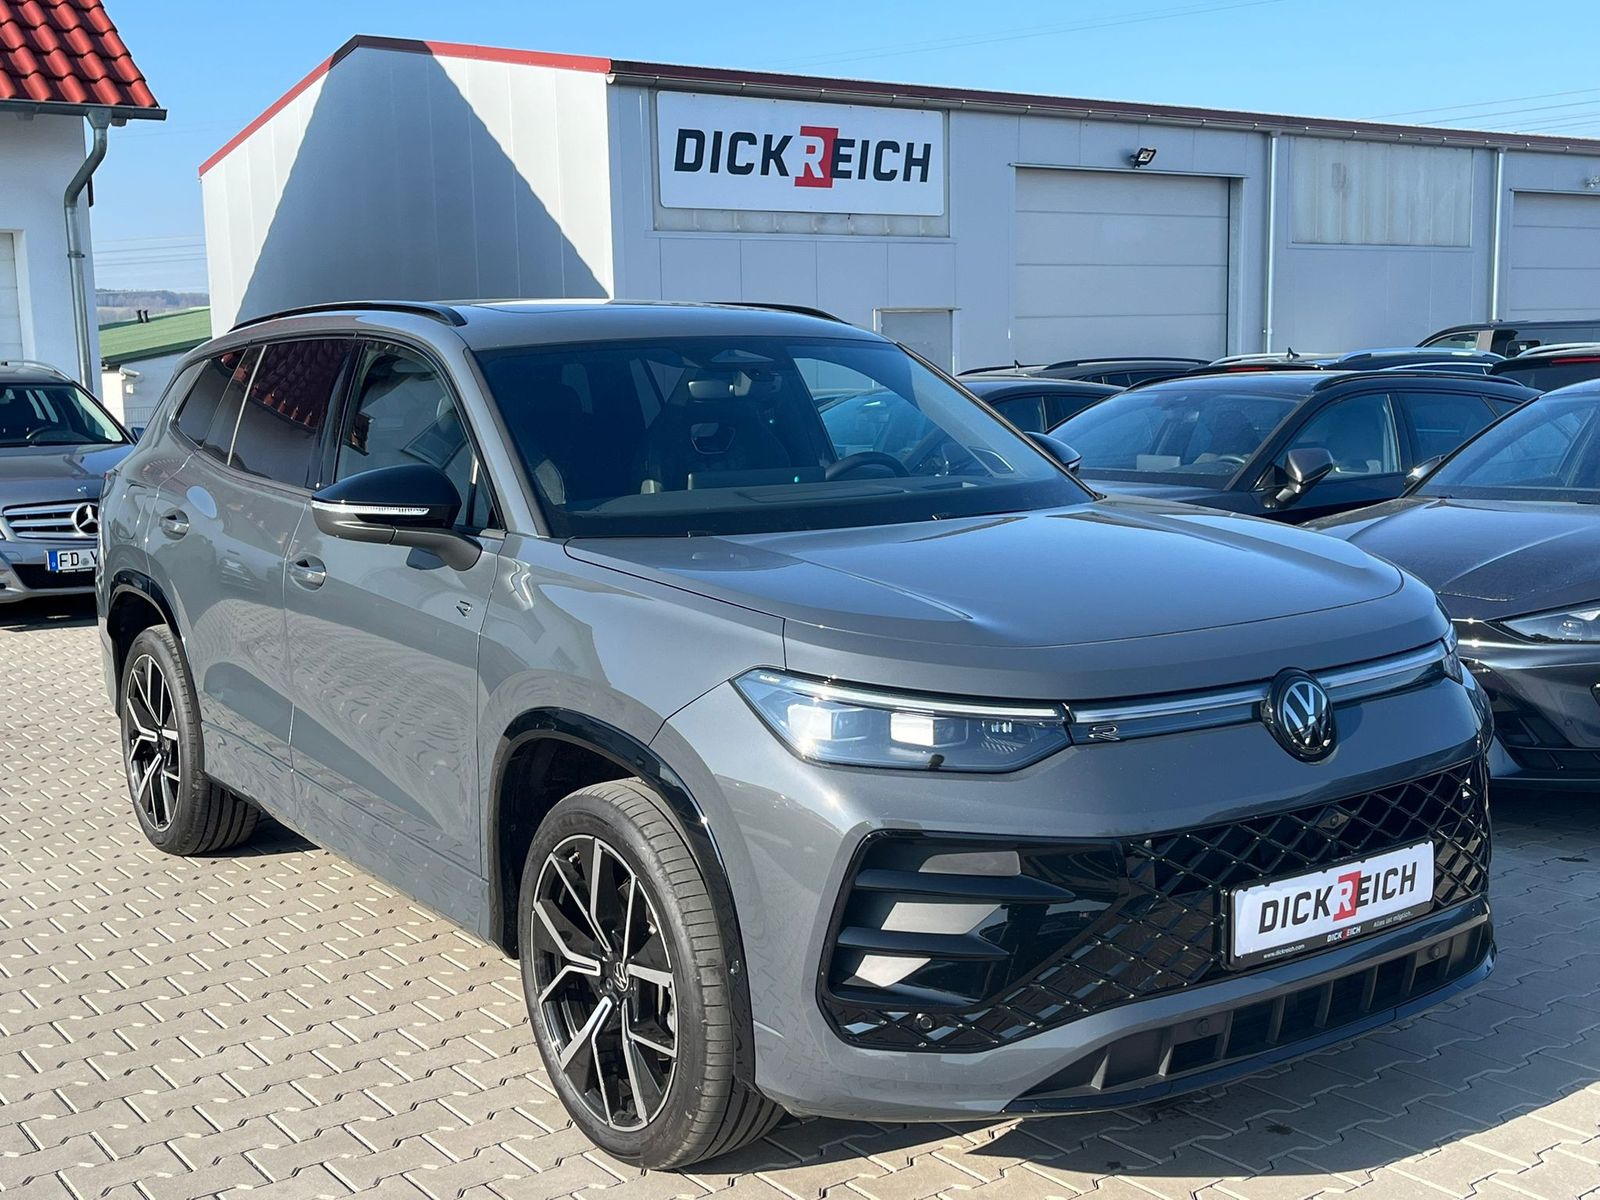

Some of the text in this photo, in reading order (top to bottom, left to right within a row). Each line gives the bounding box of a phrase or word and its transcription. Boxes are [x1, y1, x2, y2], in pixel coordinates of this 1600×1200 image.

[674, 126, 931, 188] DICKREICH
[59, 552, 80, 567] FD
[1258, 862, 1417, 934] DICKREICH
